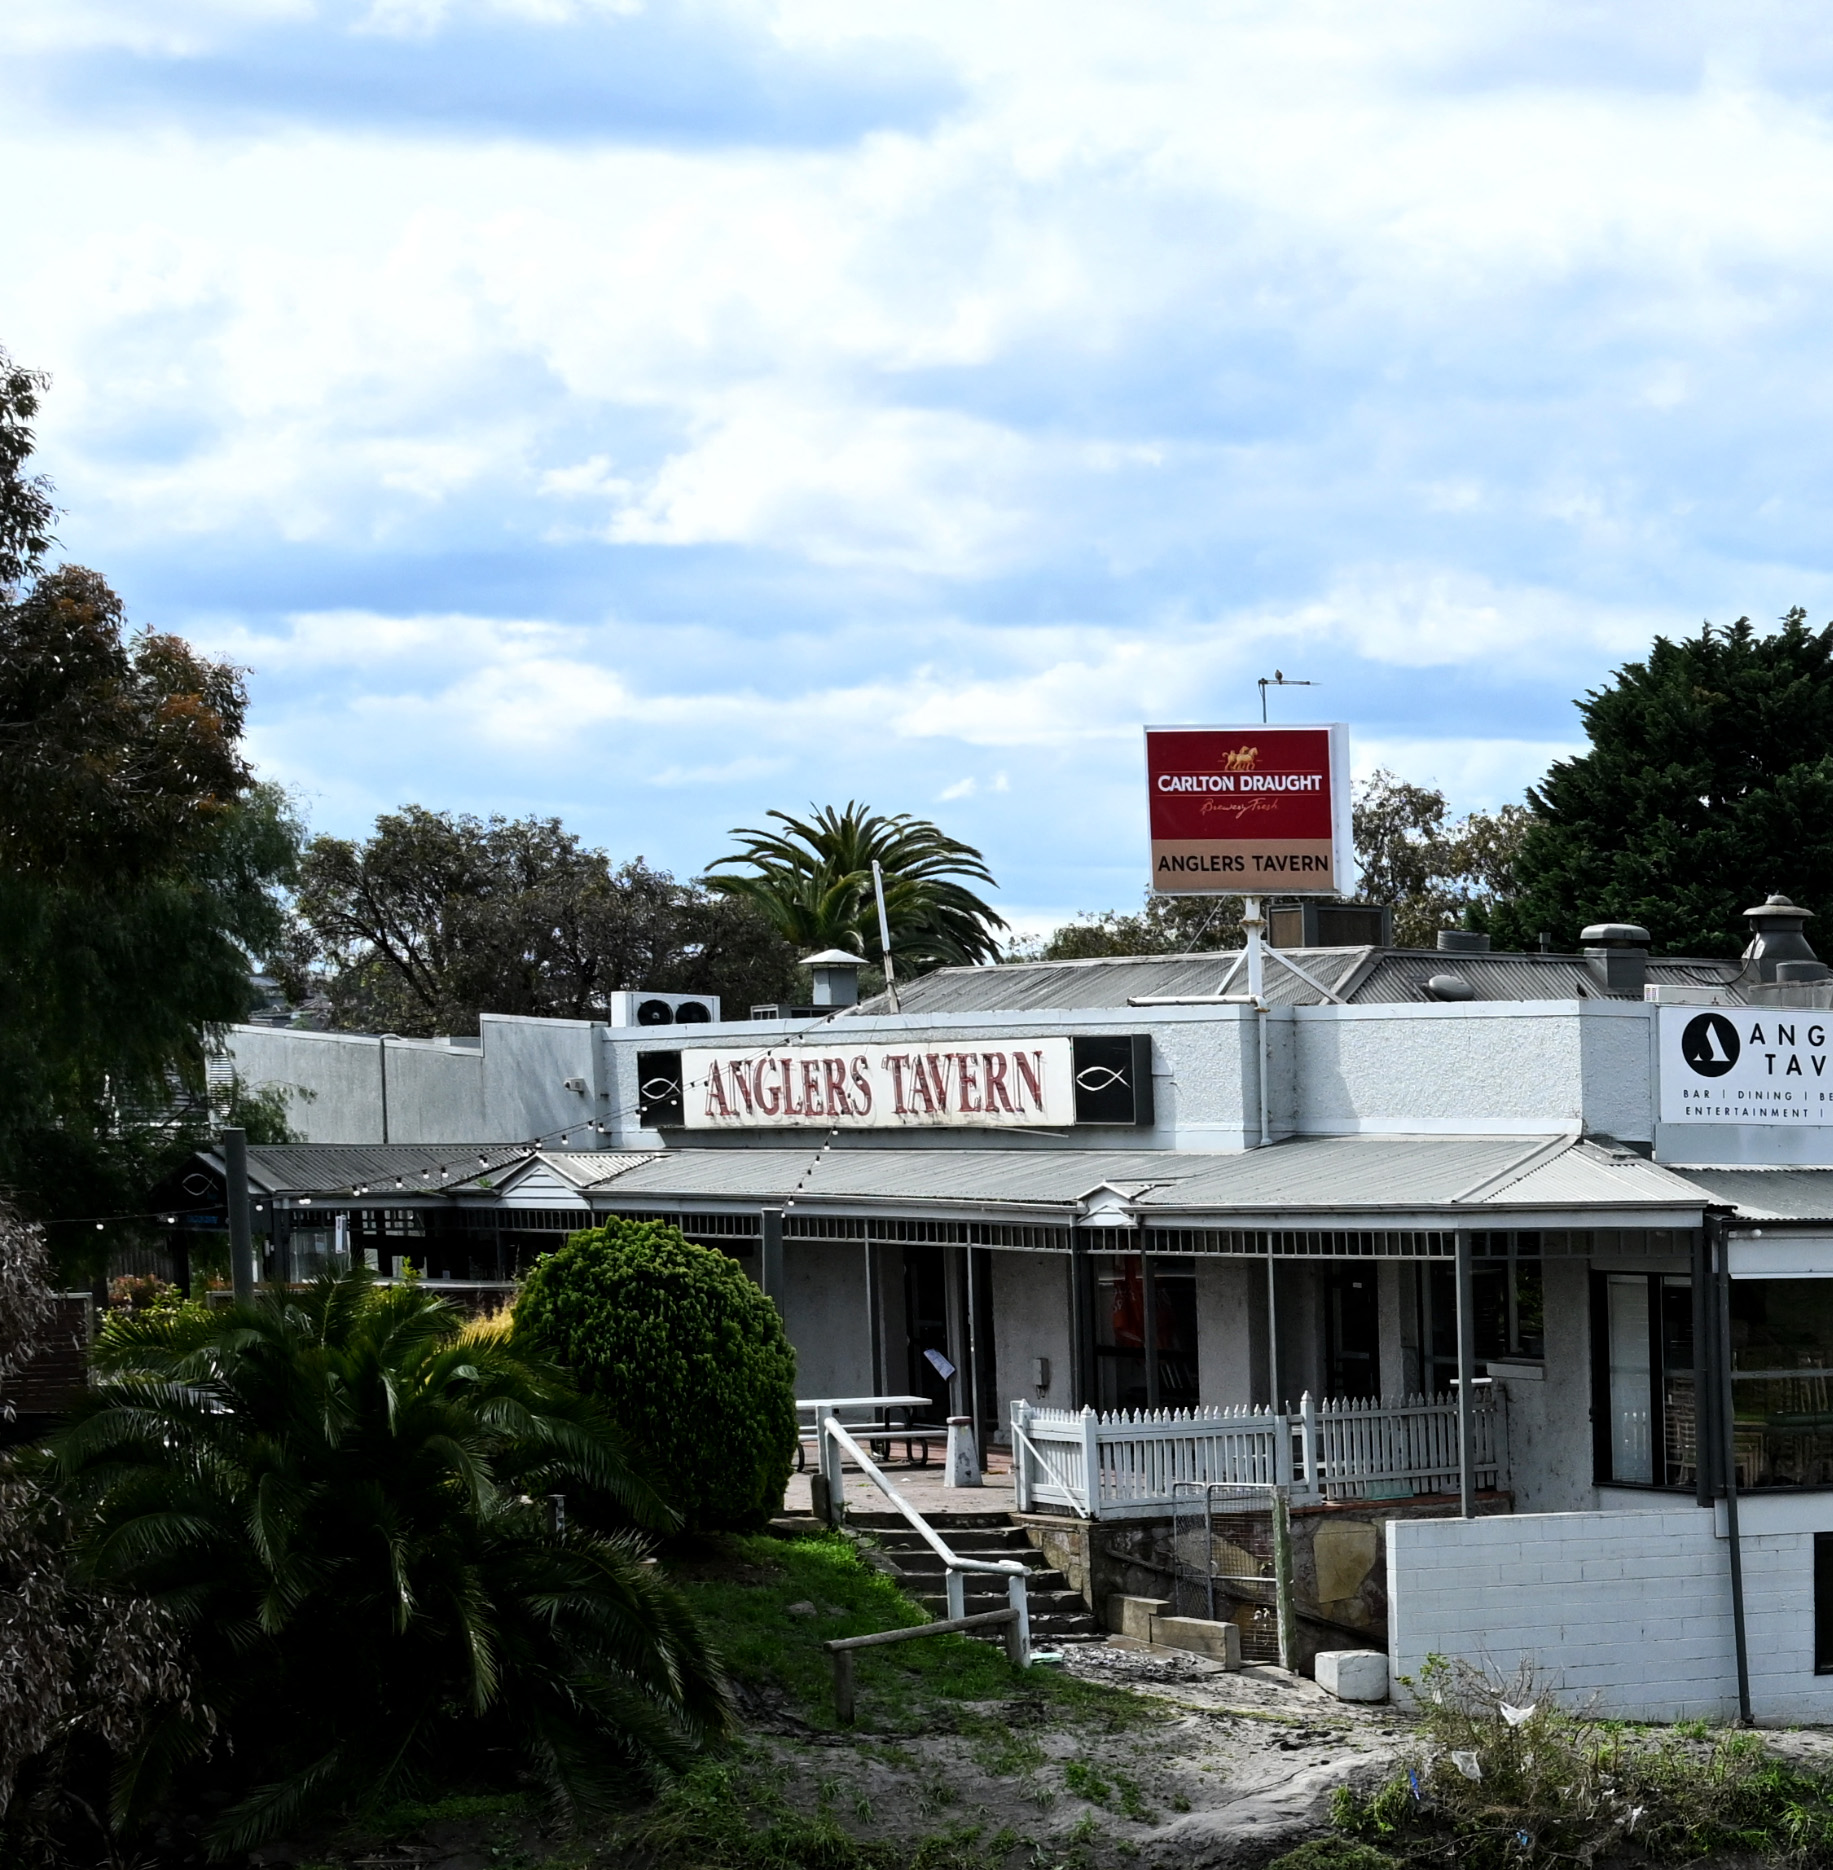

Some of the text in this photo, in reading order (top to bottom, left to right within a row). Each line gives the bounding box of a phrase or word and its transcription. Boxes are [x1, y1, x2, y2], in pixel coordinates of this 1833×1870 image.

[1157, 775, 1322, 792] CARLTON DRAUGHT
[1200, 797, 1279, 819] Brewery Fresh
[1158, 855, 1329, 872] ANGLERS TAVERN
[704, 1049, 1043, 1117] ANGLERS TAVERN
[1683, 1089, 1711, 1098] BAR
[1738, 1090, 1793, 1101] DINING
[1685, 1106, 1809, 1118] ENTERTAINMENT
